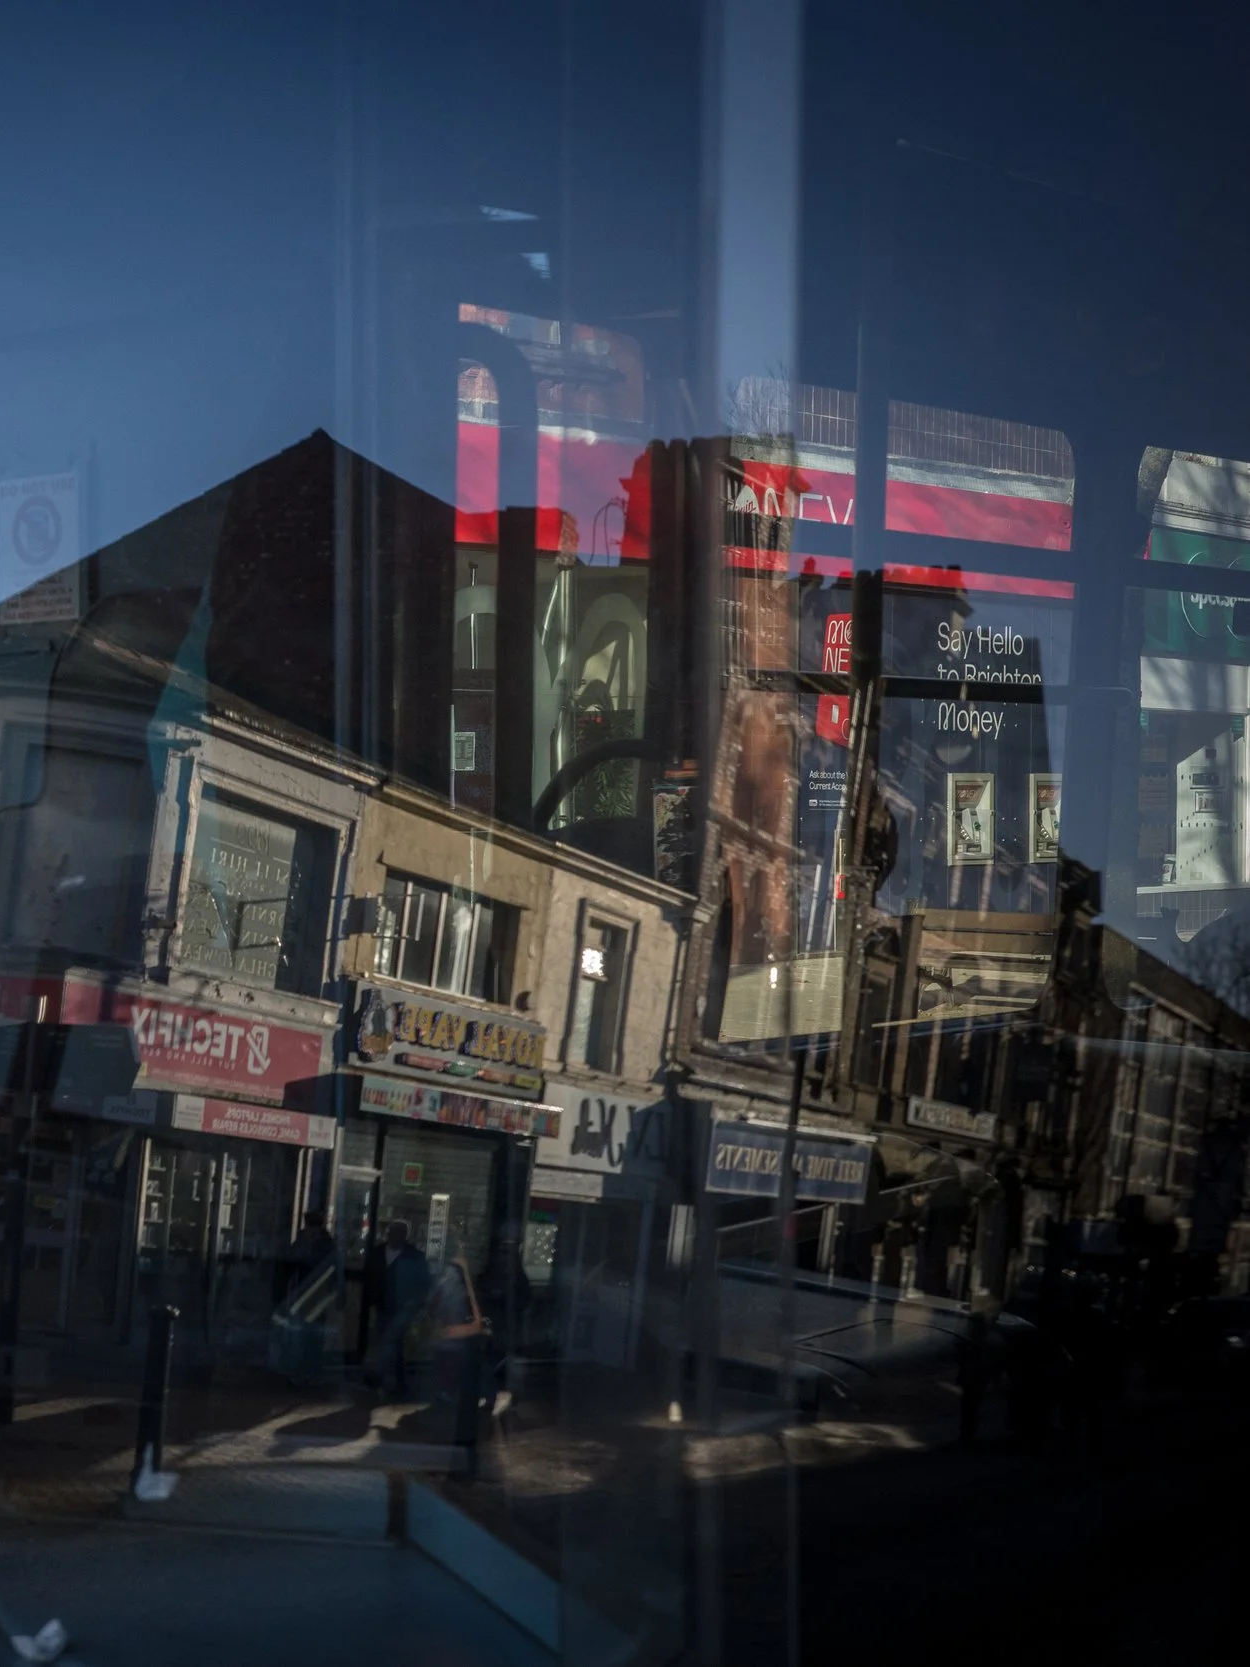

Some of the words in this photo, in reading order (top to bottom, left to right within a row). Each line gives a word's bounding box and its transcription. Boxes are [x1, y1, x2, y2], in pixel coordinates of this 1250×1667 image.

[937, 621, 972, 660] Say
[977, 625, 1024, 655] Hello
[938, 702, 1004, 740] Money
[809, 781, 831, 790] Current
